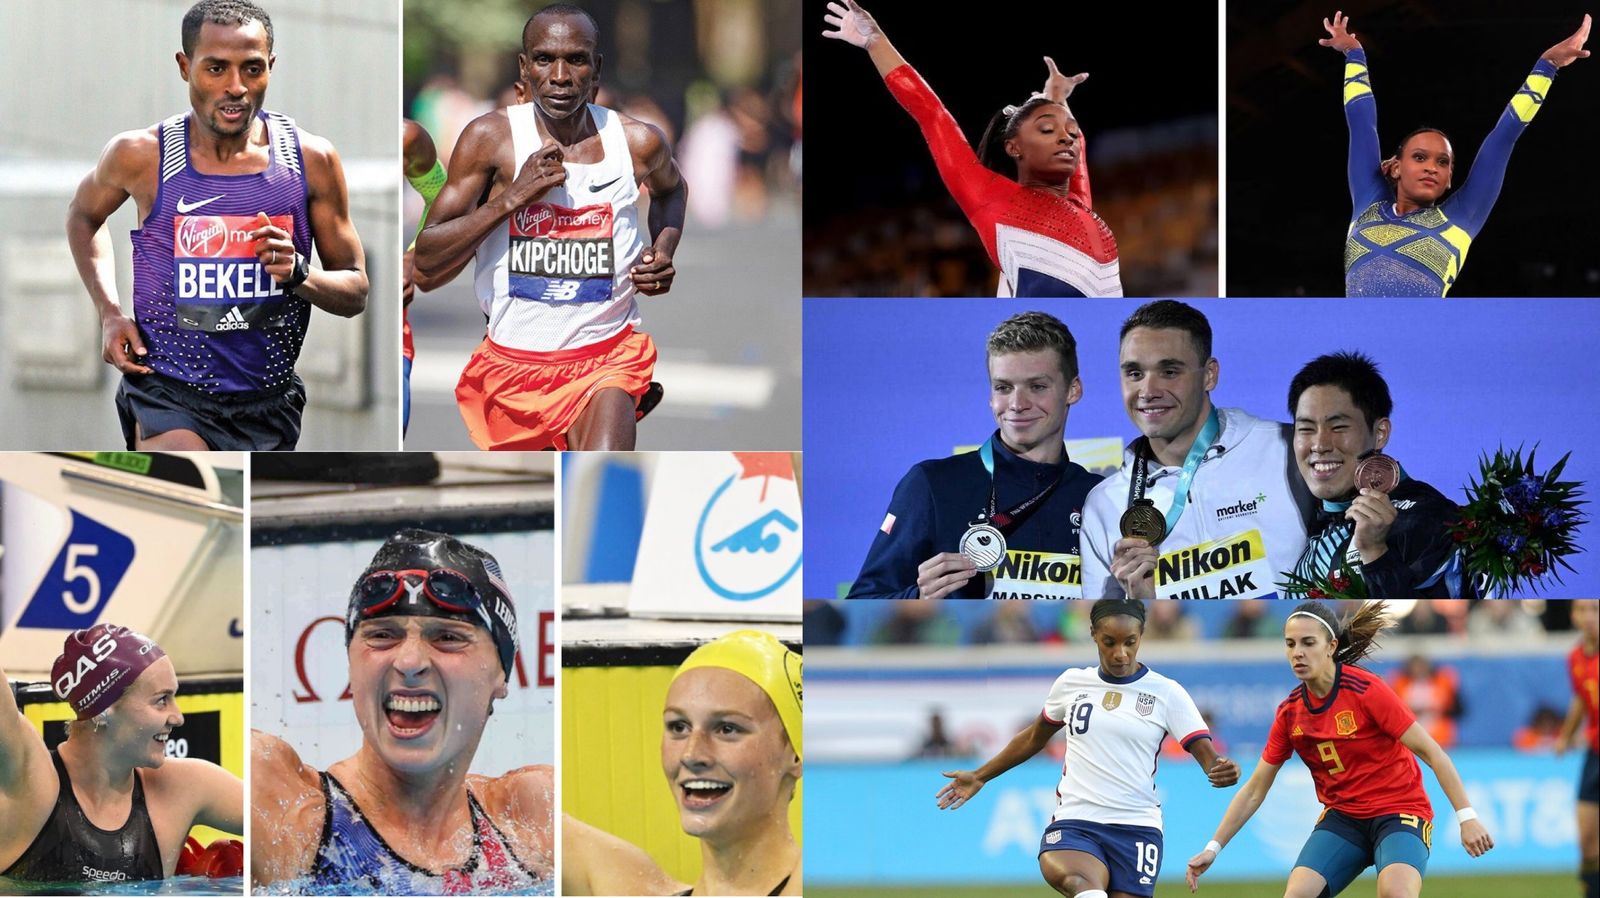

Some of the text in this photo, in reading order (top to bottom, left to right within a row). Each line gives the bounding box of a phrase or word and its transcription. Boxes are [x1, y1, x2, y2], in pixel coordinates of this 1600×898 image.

[182, 223, 222, 253] Virgin
[517, 208, 609, 234] Virgin money
[511, 241, 609, 275] KIPCHOGE
[216, 320, 249, 331] adidas
[1216, 500, 1257, 517] market
[62, 544, 101, 615] 5
[1159, 540, 1251, 586] Nikon
[1169, 571, 1258, 600] LAK
[55, 634, 118, 699] QAS
[78, 668, 119, 706] TITMUS
[1139, 697, 1154, 706] USA
[1069, 702, 1094, 736] 19
[1316, 740, 1346, 776] 9
[82, 865, 126, 881] speedo
[1135, 842, 1159, 877] 19
